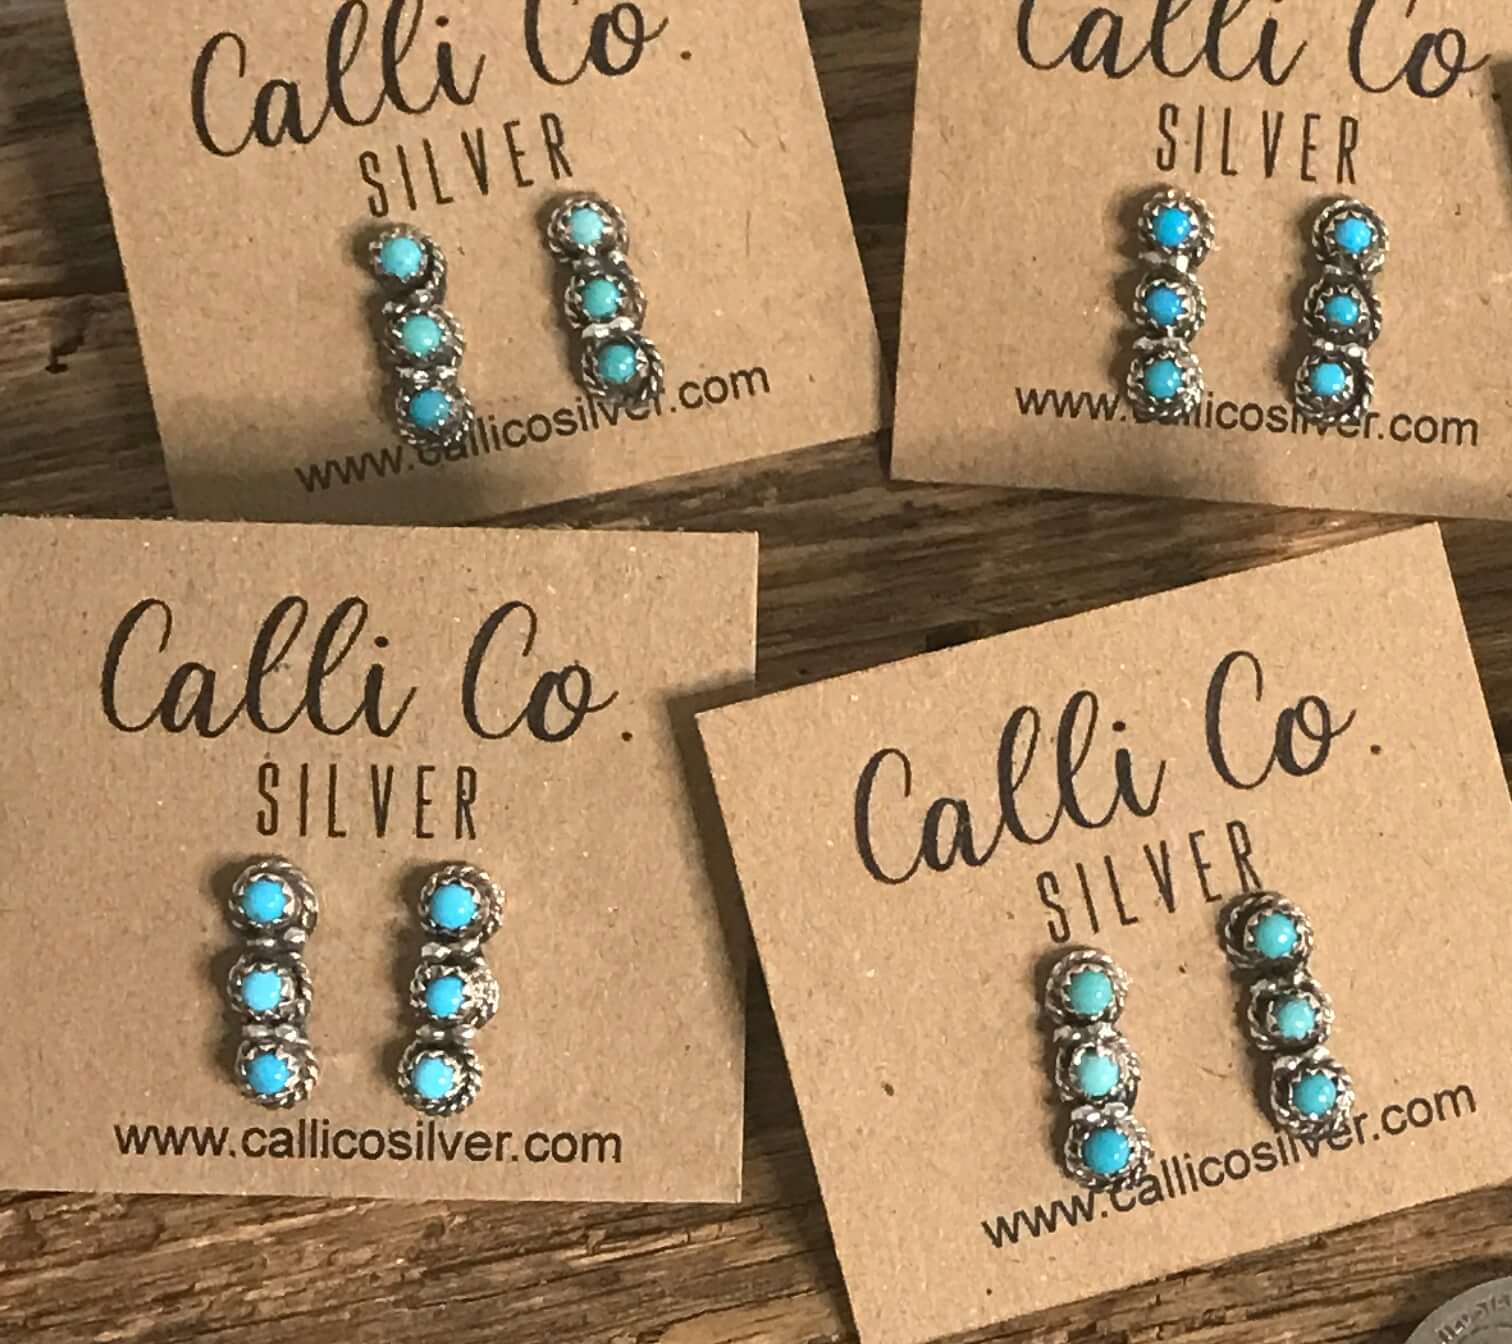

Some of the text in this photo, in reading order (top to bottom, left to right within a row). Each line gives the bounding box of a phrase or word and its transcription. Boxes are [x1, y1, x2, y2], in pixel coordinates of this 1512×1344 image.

[359, 112, 573, 218] SILVER
[1155, 103, 1359, 184] SILVER
[100, 595, 633, 743] Calli Co.
[256, 761, 478, 840] SILVER
[853, 650, 1382, 886] Calli Co.
[1036, 819, 1265, 945] SILVER
[113, 1118, 623, 1164] www.callicosilver.com
[980, 1081, 1479, 1249] www.callicosilver.com
